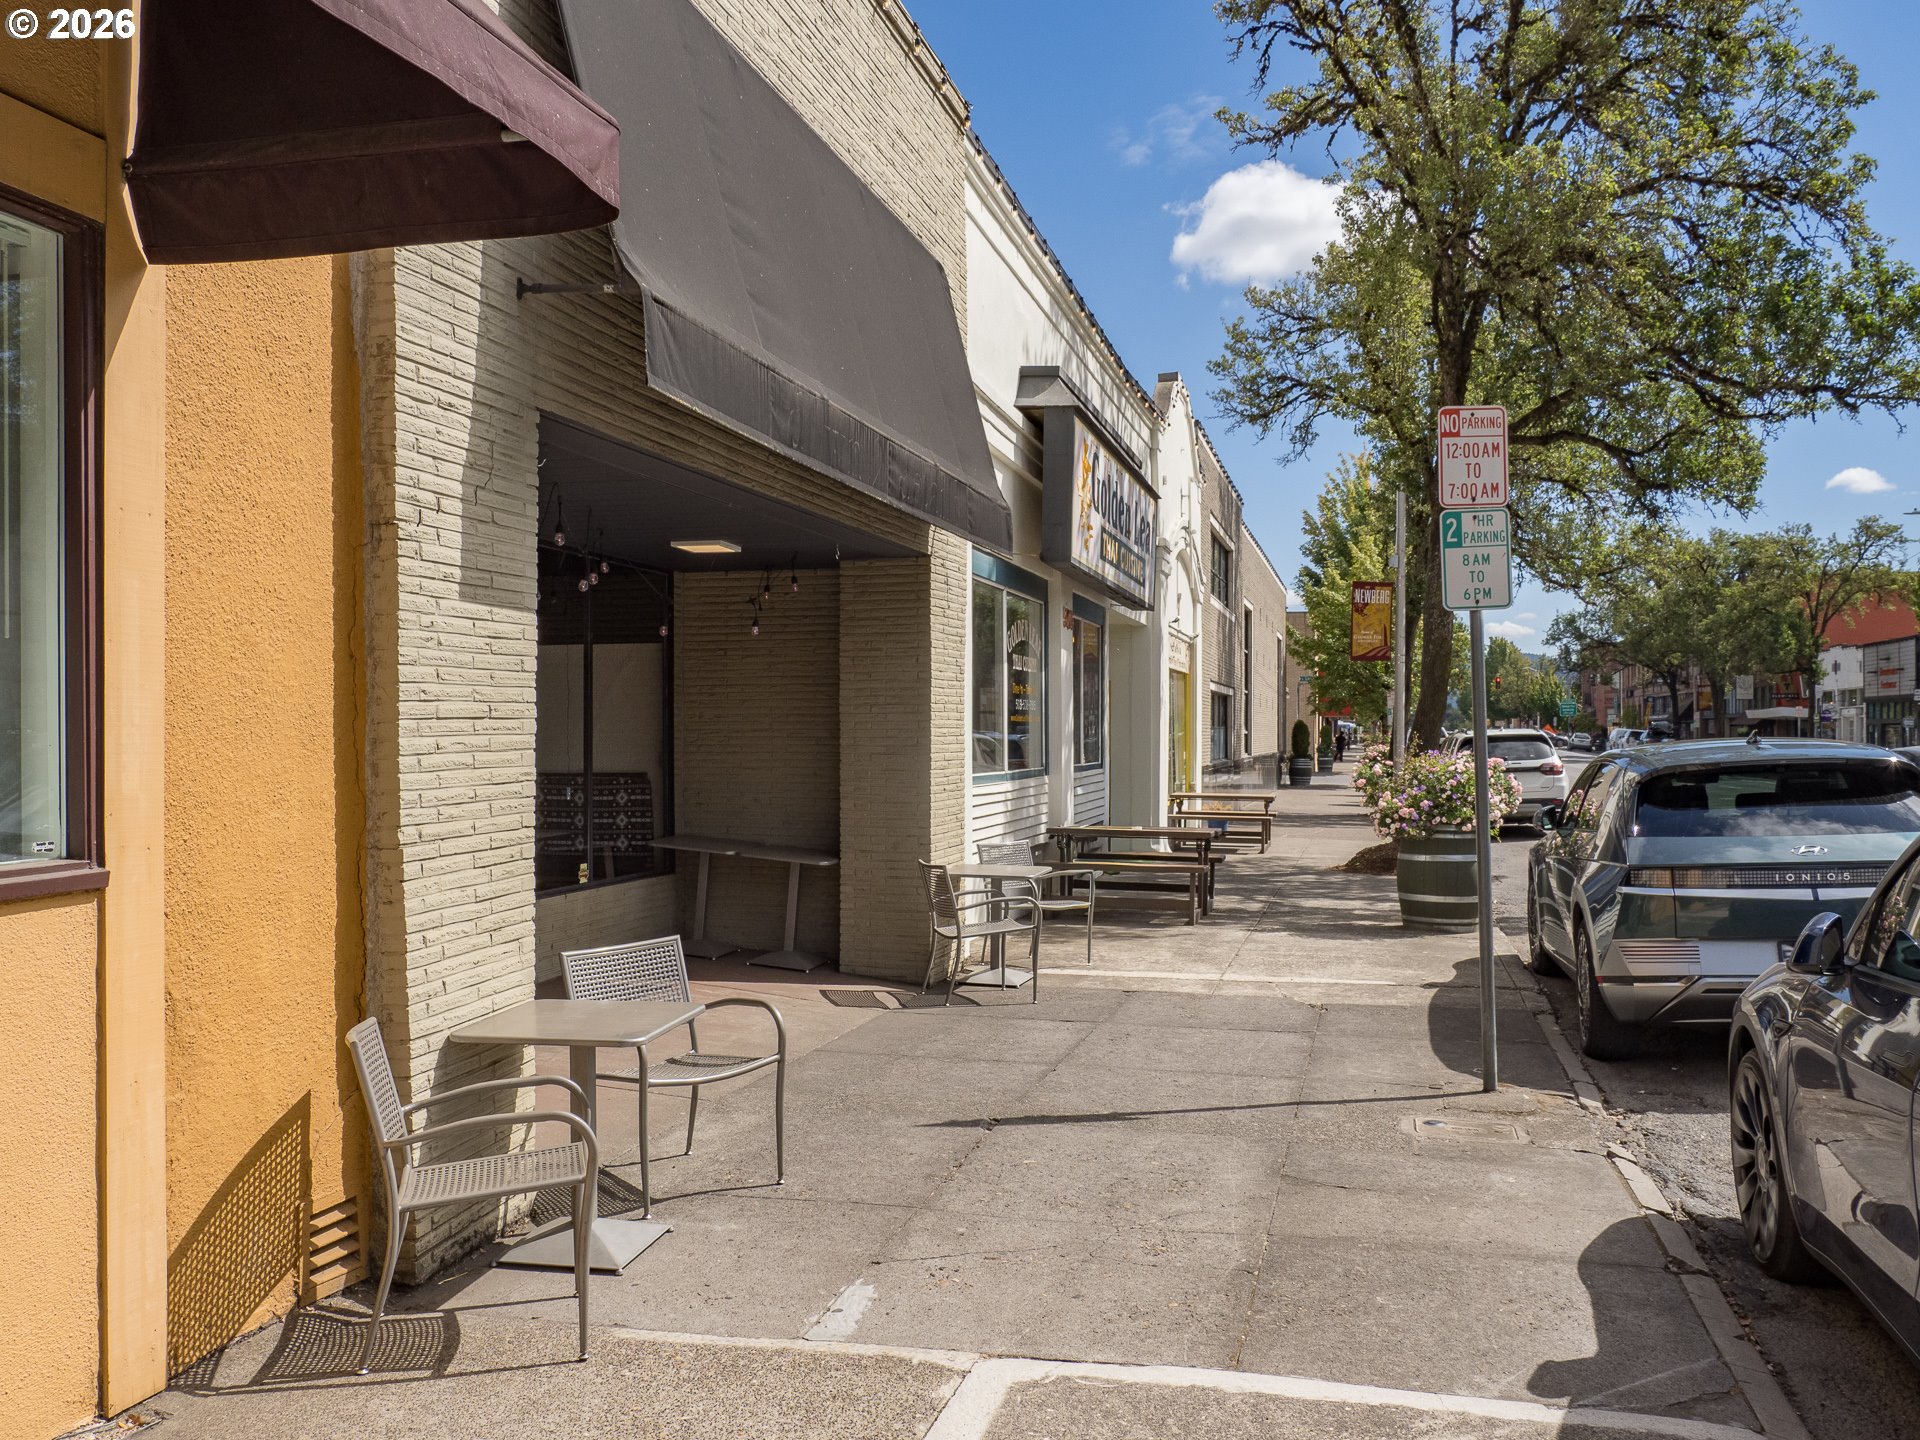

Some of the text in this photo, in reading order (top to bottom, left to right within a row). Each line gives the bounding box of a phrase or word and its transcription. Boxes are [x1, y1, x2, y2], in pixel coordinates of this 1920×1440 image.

[1440, 414, 1502, 433] NO PARKING
[1465, 462, 1482, 479] TO
[1091, 451, 1132, 541] Golden
[1476, 514, 1494, 527] HR
[1446, 517, 1458, 543] 2
[1463, 529, 1506, 544] PARKING
[1102, 532, 1119, 565] THAI
[1469, 570, 1485, 583] TO
[1354, 588, 1390, 604] NEWBERG
